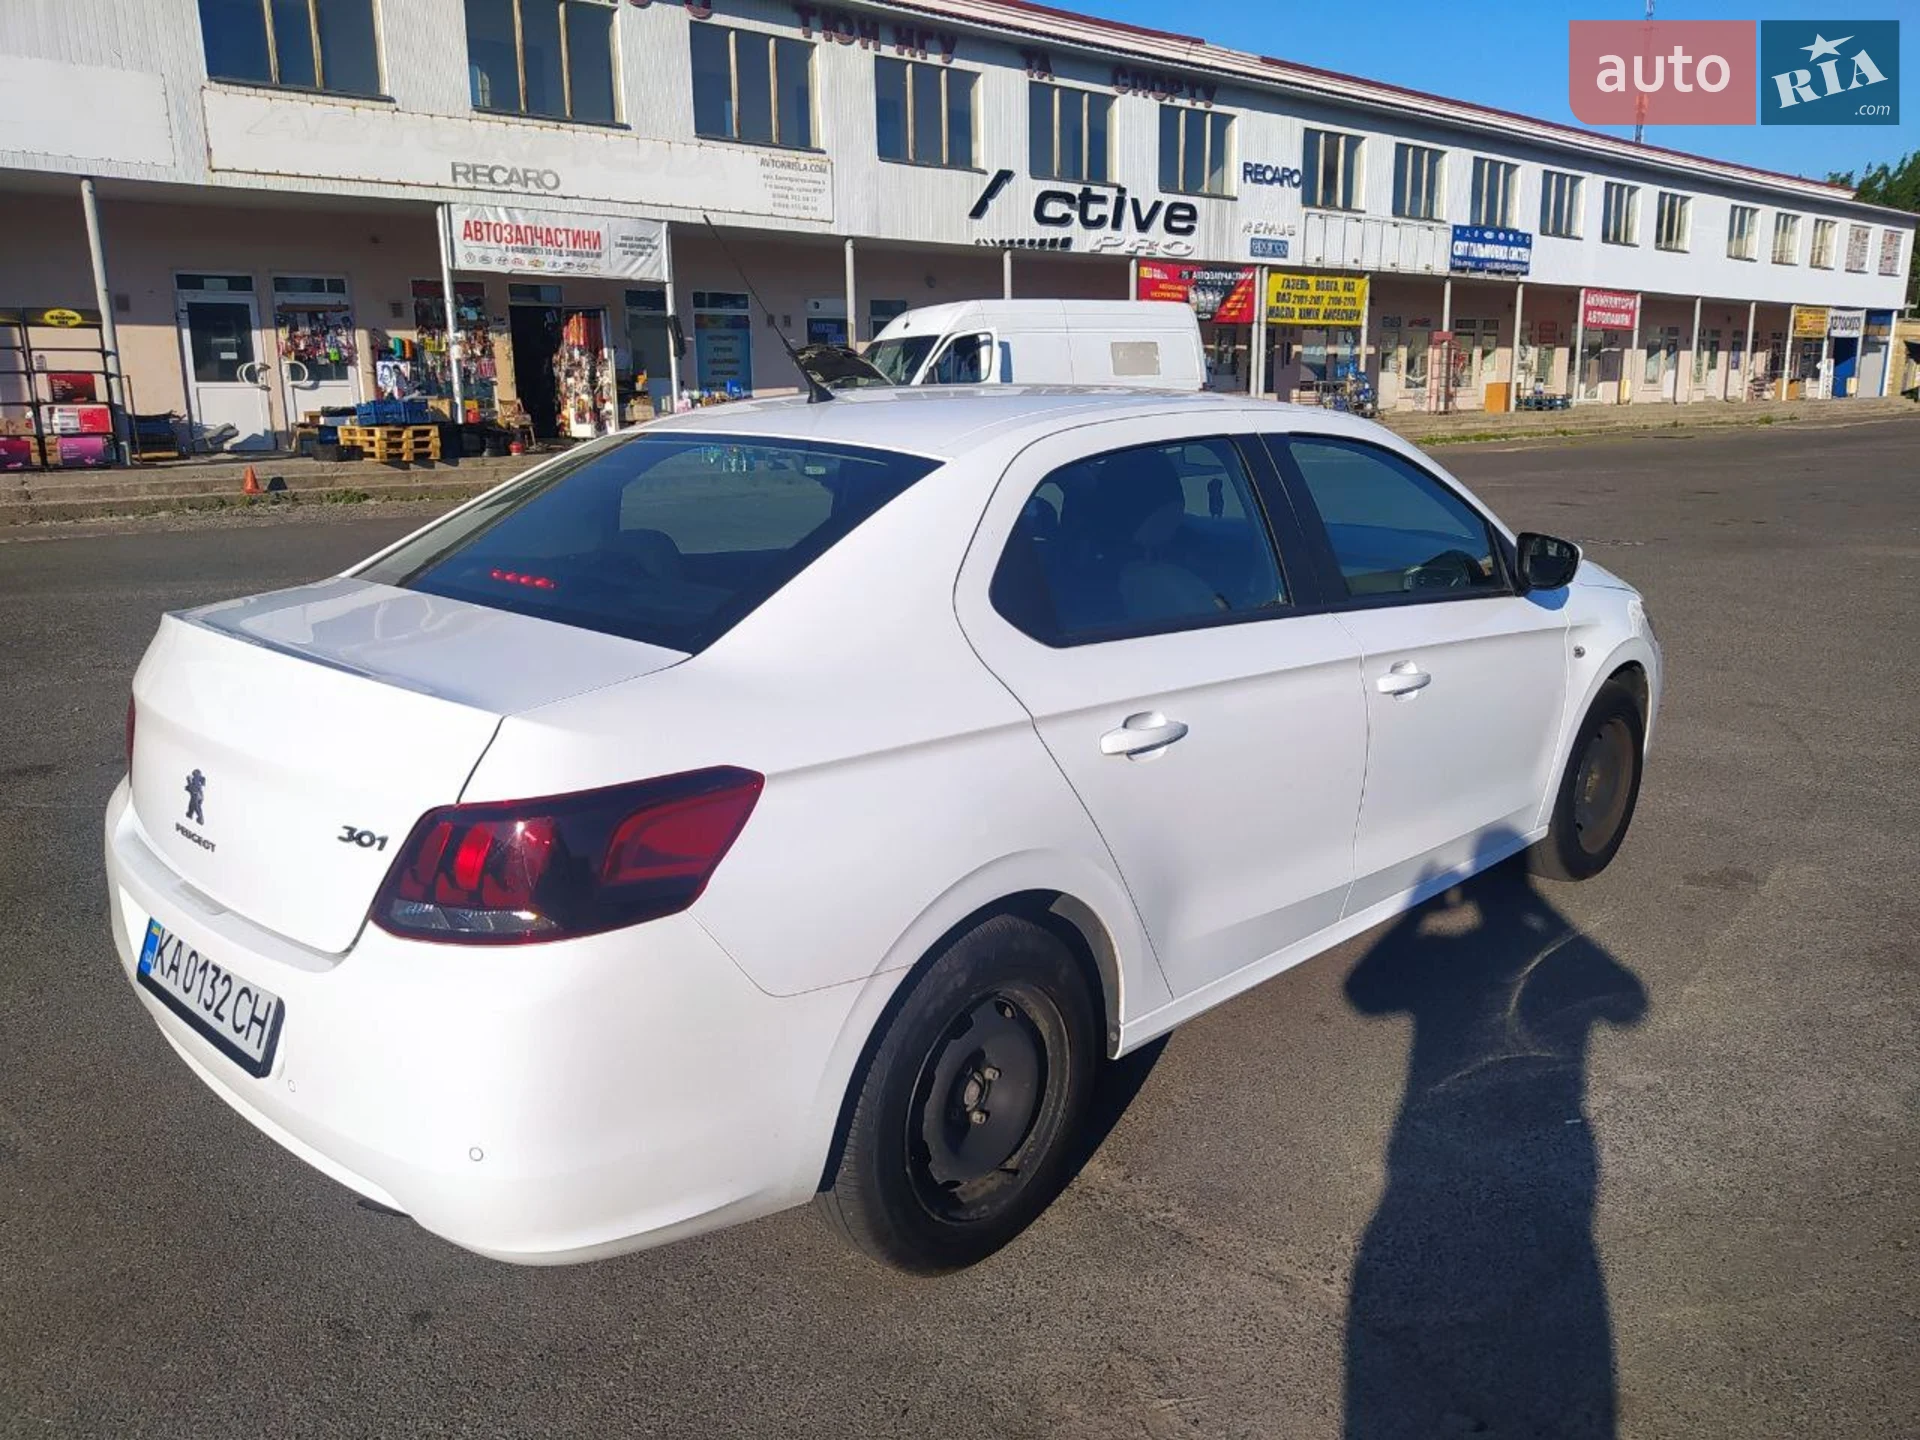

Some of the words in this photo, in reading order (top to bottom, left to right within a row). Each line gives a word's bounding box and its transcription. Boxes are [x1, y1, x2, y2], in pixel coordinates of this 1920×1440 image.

[451, 161, 561, 190] RECARO
[1243, 161, 1302, 189] RECARO
[463, 219, 602, 250] АВТОЗАПЧАСТИНИ
[175, 822, 216, 852] PEUGEOT
[337, 825, 389, 851] 301
